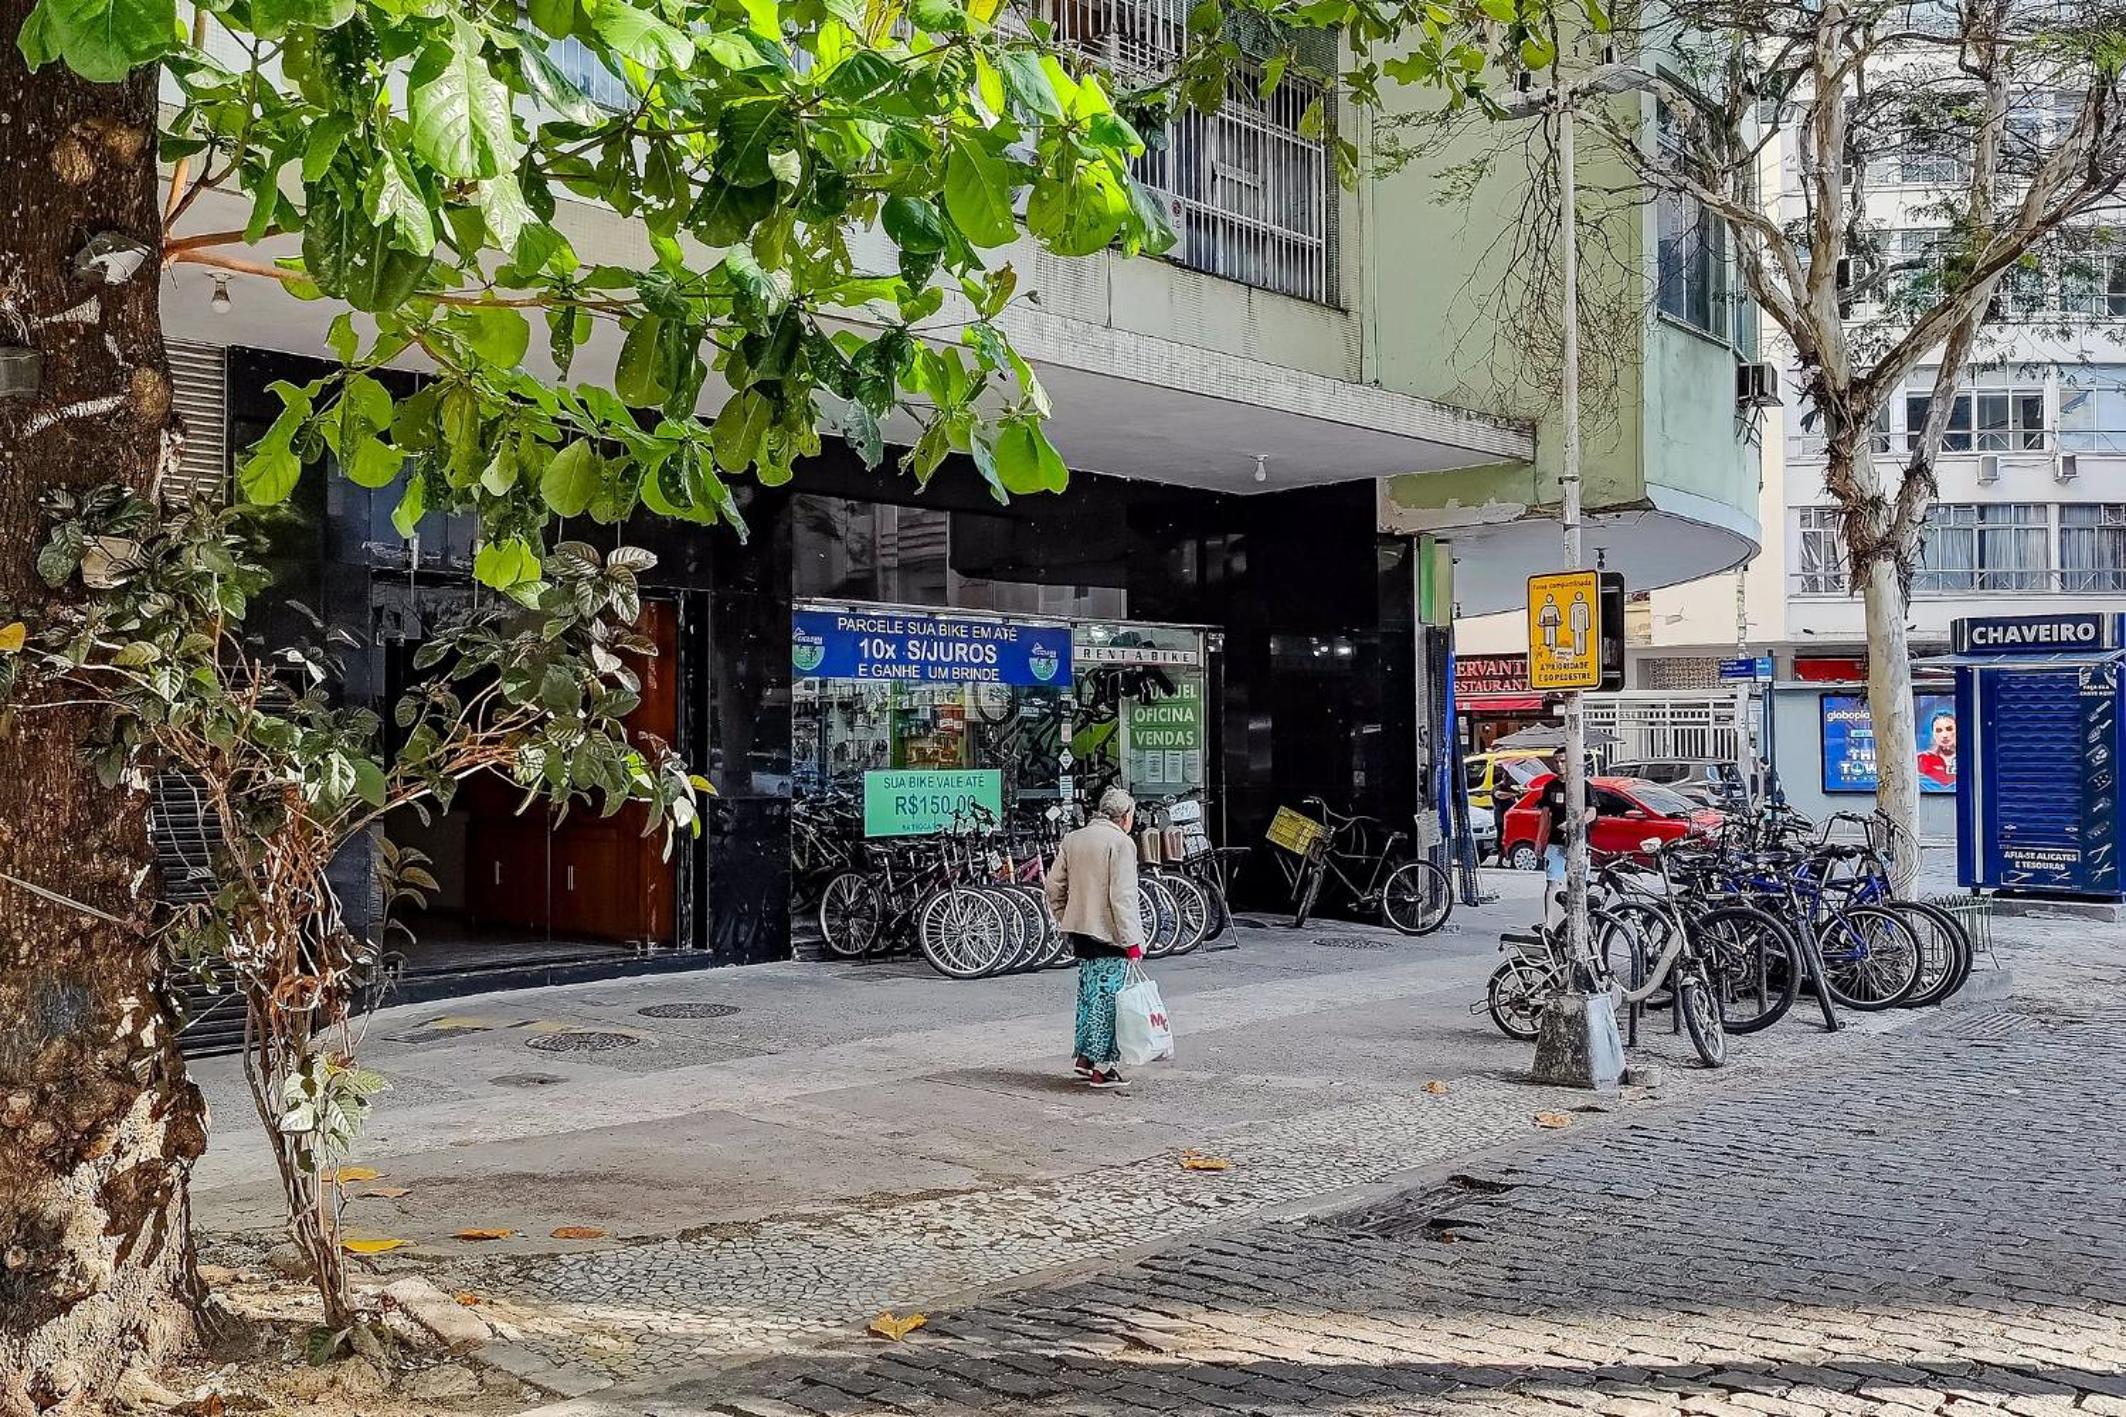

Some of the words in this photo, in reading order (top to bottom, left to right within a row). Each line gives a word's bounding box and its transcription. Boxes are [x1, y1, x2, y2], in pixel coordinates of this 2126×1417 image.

[838, 618, 904, 635] PARCELE
[907, 623, 936, 636] SUA
[939, 625, 969, 639] BIKE
[972, 626, 994, 640] EM
[995, 626, 1018, 642] ATÉ
[1972, 623, 2095, 644] CHAVEIRO
[859, 638, 897, 660] 10x
[906, 640, 998, 664] S/JUROS
[1083, 648, 1126, 660] RENT
[1135, 650, 1143, 661] A
[1151, 650, 1190, 662] BIKE
[858, 665, 867, 677] E
[871, 664, 921, 679] GANHE
[928, 666, 949, 679] UM
[951, 667, 1000, 681] BRINDE
[1134, 707, 1195, 723] OFICINA
[1826, 710, 1871, 722] globopla
[1135, 730, 1194, 746] VENDAS
[1840, 762, 1878, 775] TOW
[884, 777, 905, 789] SUA
[909, 776, 934, 789] BIKE
[936, 775, 963, 788] VALE
[965, 773, 985, 788] ATÉ
[2036, 852, 2077, 862] ALICATES
[2022, 861, 2066, 871] TESOURAS
